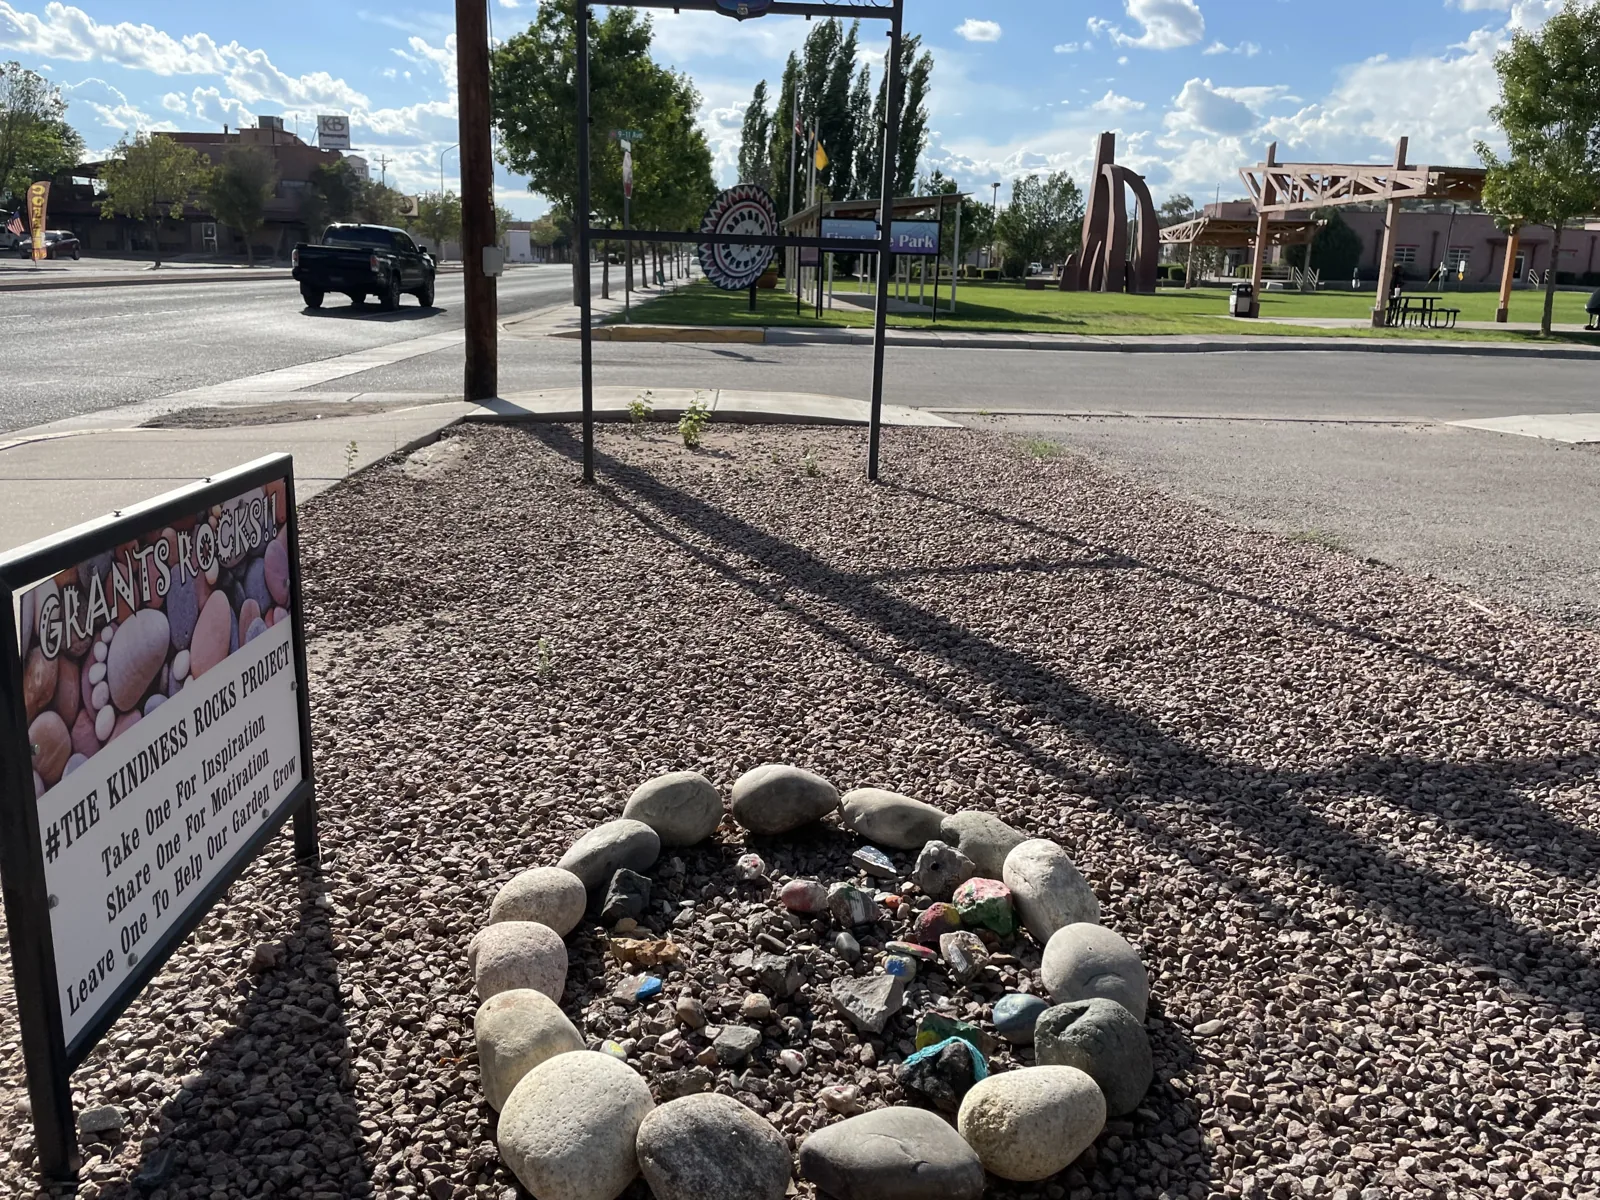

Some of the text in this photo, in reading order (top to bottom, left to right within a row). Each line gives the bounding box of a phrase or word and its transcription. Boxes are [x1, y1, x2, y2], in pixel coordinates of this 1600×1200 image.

[899, 234, 933, 247] Park
[39, 493, 277, 659] GRANTS ROCKS!!
[45, 640, 291, 864] #THE KINDNESS ROCKS PROJECT
[101, 714, 266, 878] Take One For Inspiration
[106, 747, 270, 924] Share One For Motivation
[66, 756, 297, 1017] Leave One To Help Our Garden Grow
